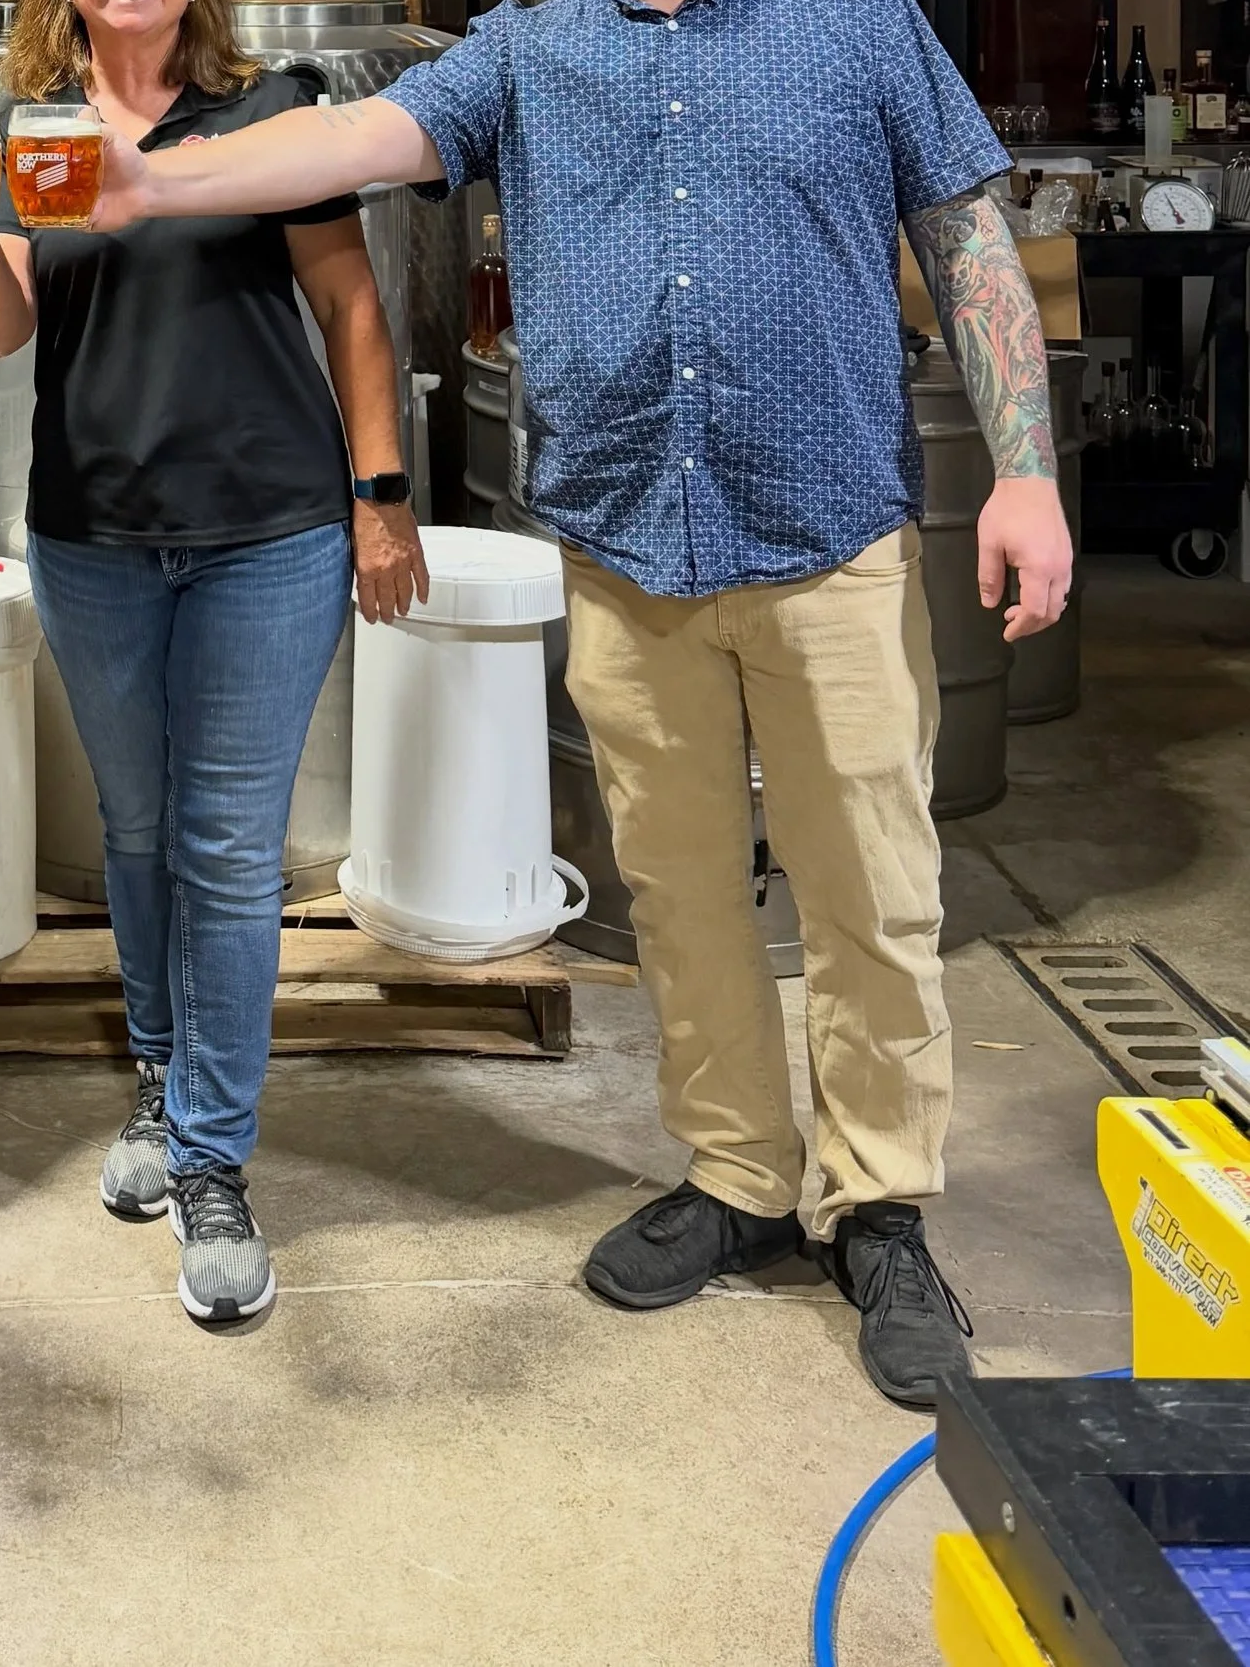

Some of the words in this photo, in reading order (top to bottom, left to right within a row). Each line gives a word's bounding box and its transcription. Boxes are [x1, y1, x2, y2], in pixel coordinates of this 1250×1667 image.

[16, 152, 68, 162] NORTHERN
[16, 161, 37, 170] ROW
[1147, 1198, 1240, 1306] Direct
